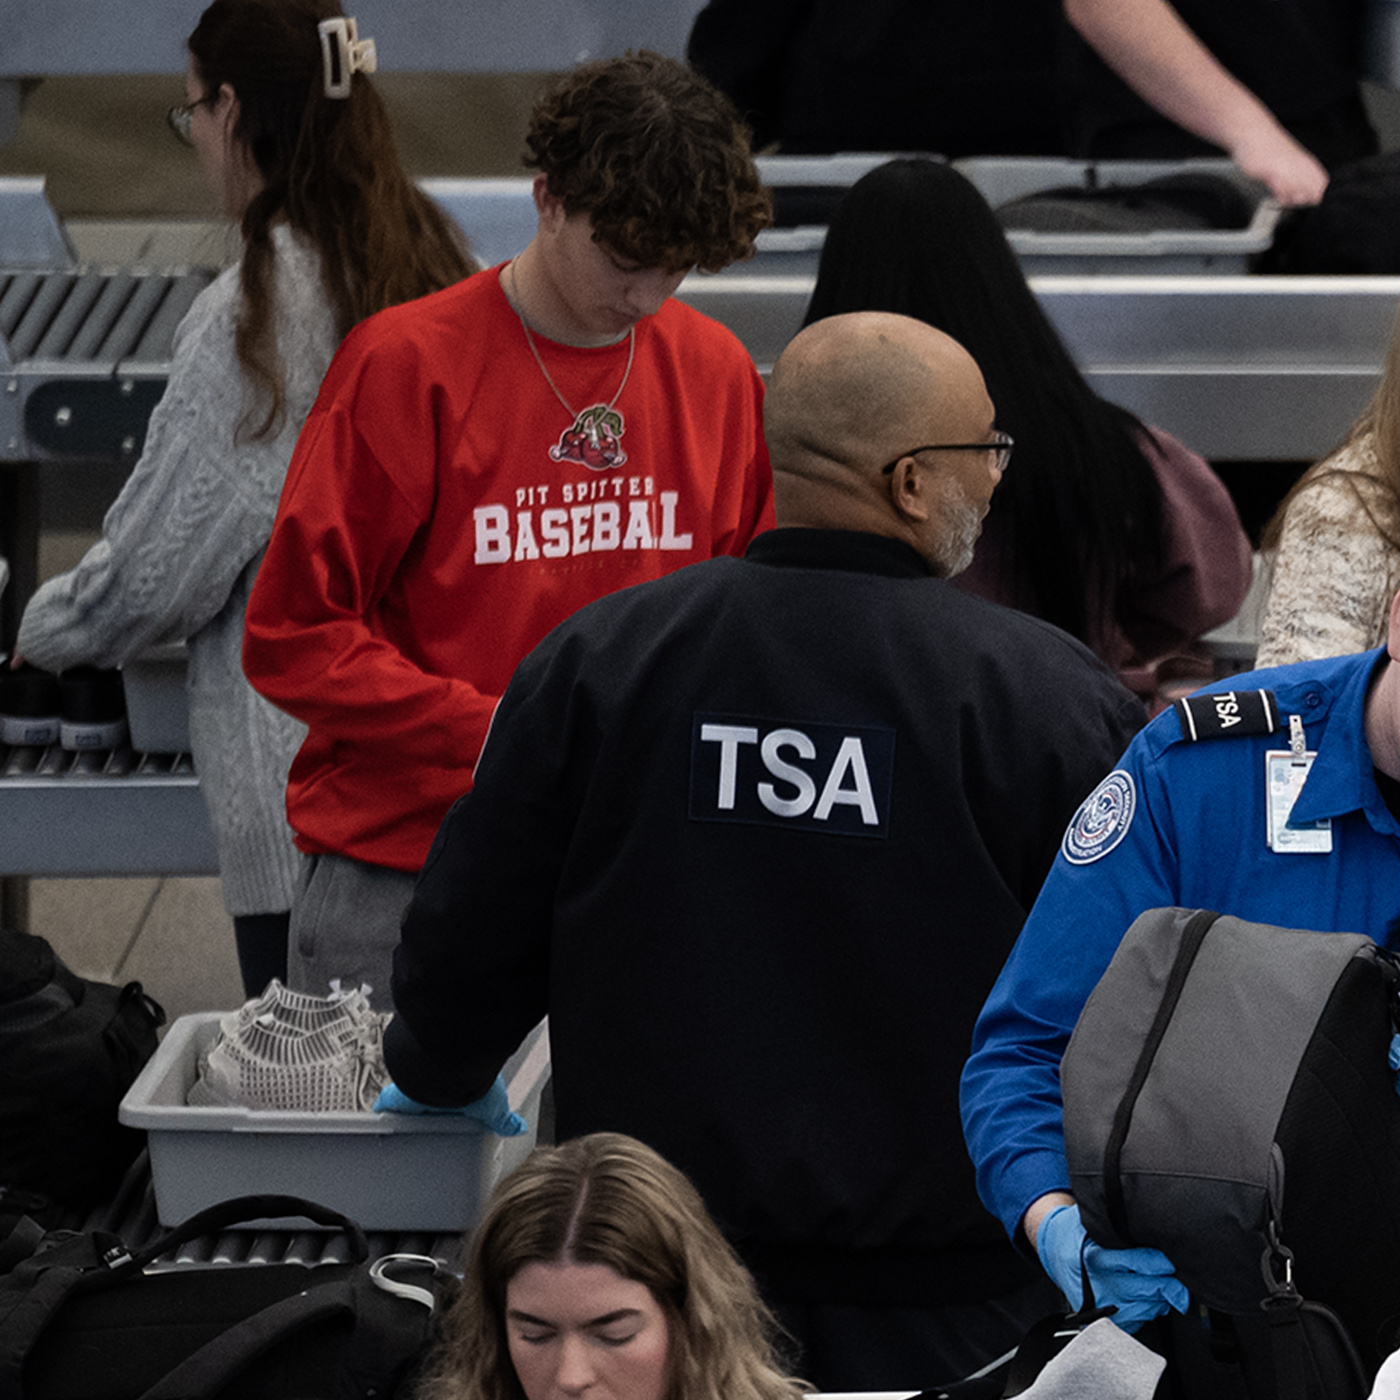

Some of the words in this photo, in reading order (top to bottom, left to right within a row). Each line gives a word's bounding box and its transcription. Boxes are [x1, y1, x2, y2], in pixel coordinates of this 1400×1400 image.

[515, 485, 549, 507] PIT
[473, 491, 693, 565] BASEBAL
[1213, 691, 1243, 729] TSA
[701, 724, 880, 826] TSA
